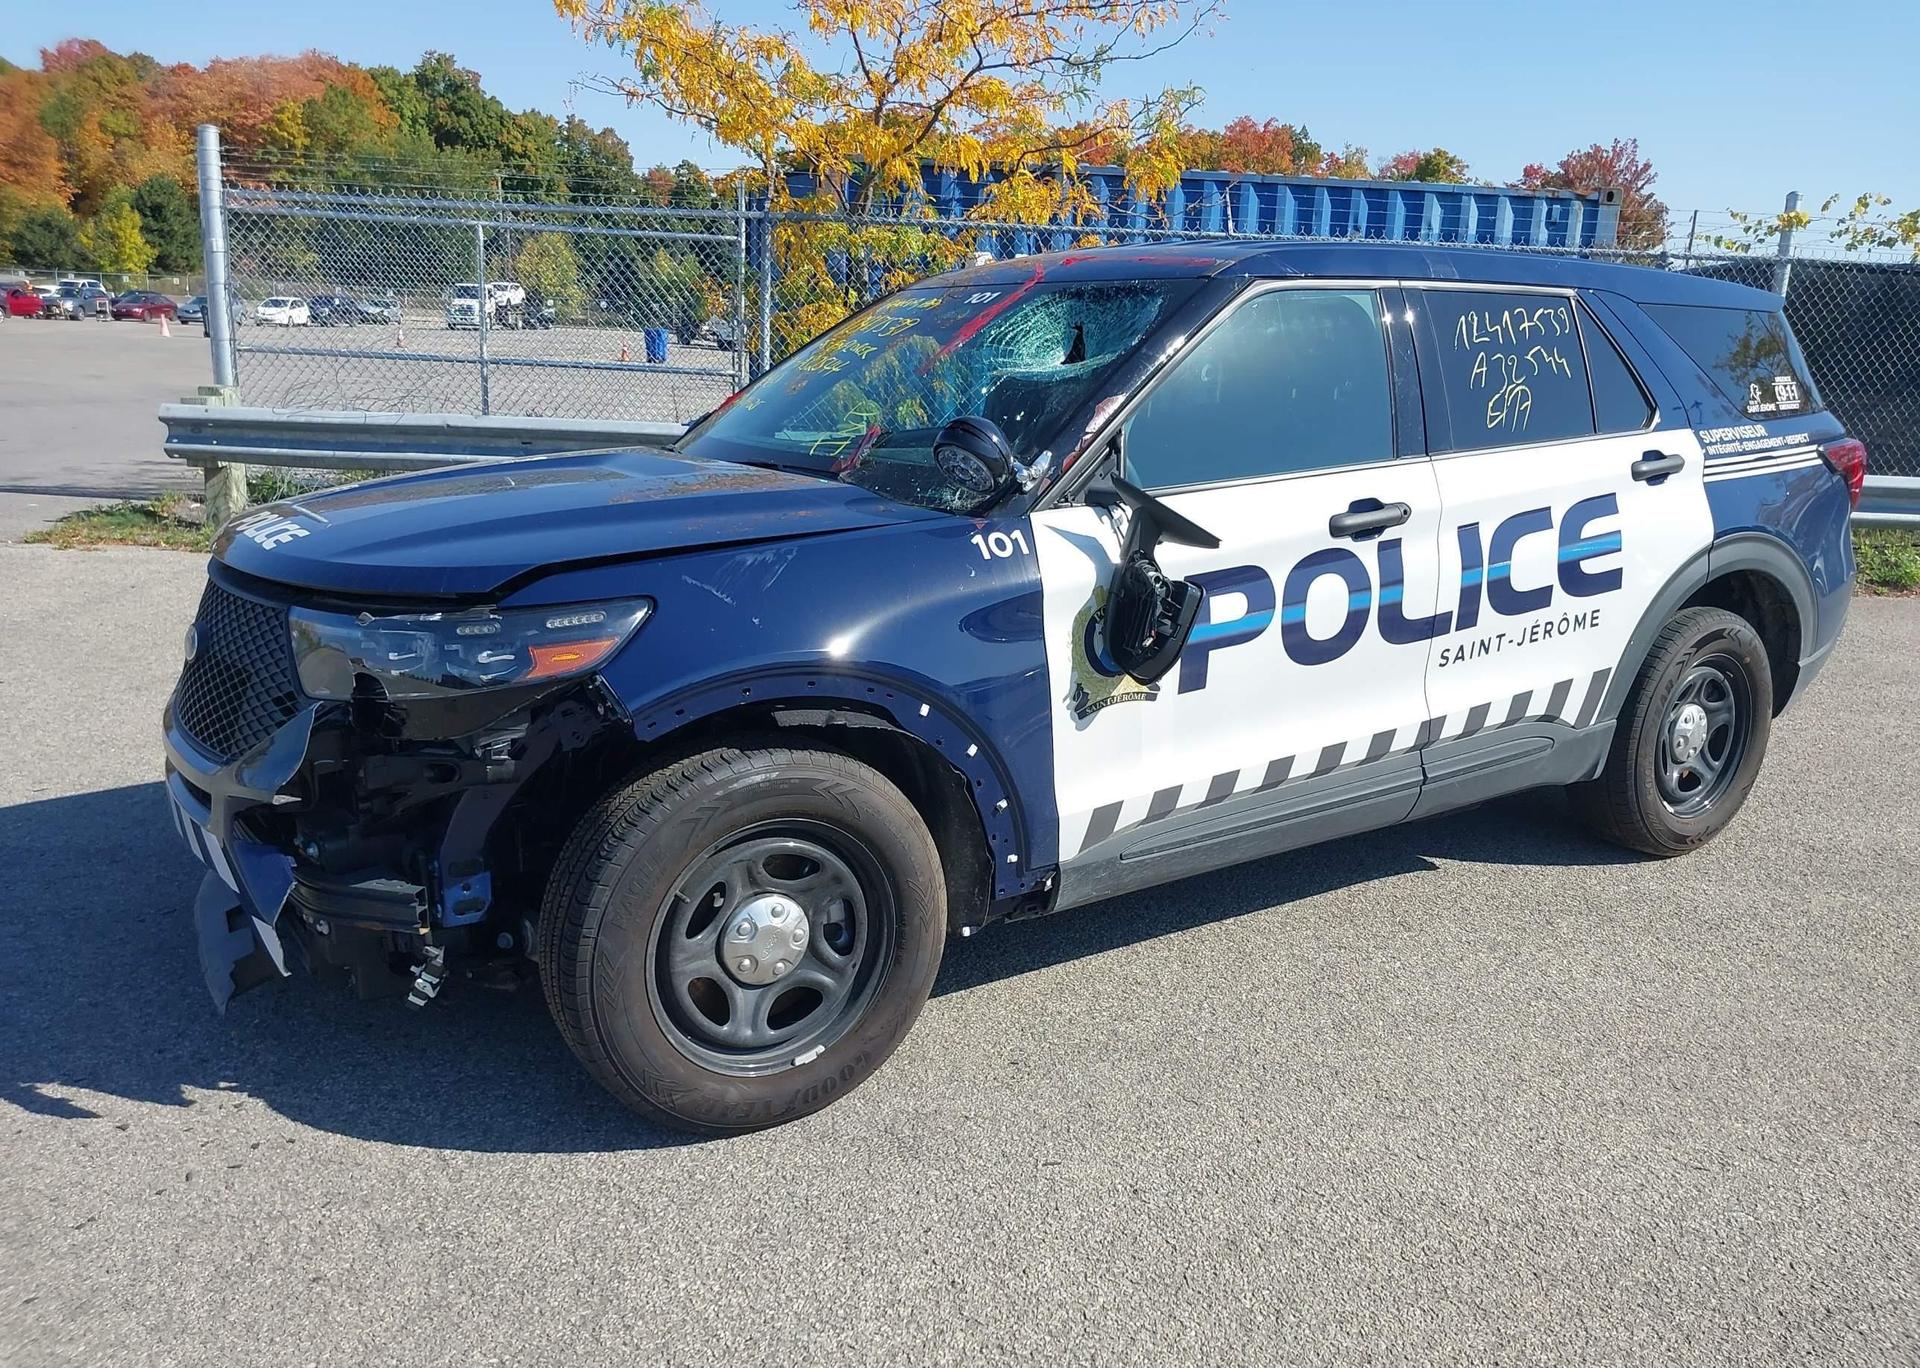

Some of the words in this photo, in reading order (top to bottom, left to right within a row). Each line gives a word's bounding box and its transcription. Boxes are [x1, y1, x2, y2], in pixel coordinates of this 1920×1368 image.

[964, 292, 1002, 304] 101
[1699, 424, 1768, 443] SUPERVISEUR
[228, 511, 311, 550] POLICE
[971, 530, 1030, 560] 101
[1177, 492, 1623, 696] POLICE
[1438, 609, 1601, 668] SAINT-JÉRÔME
